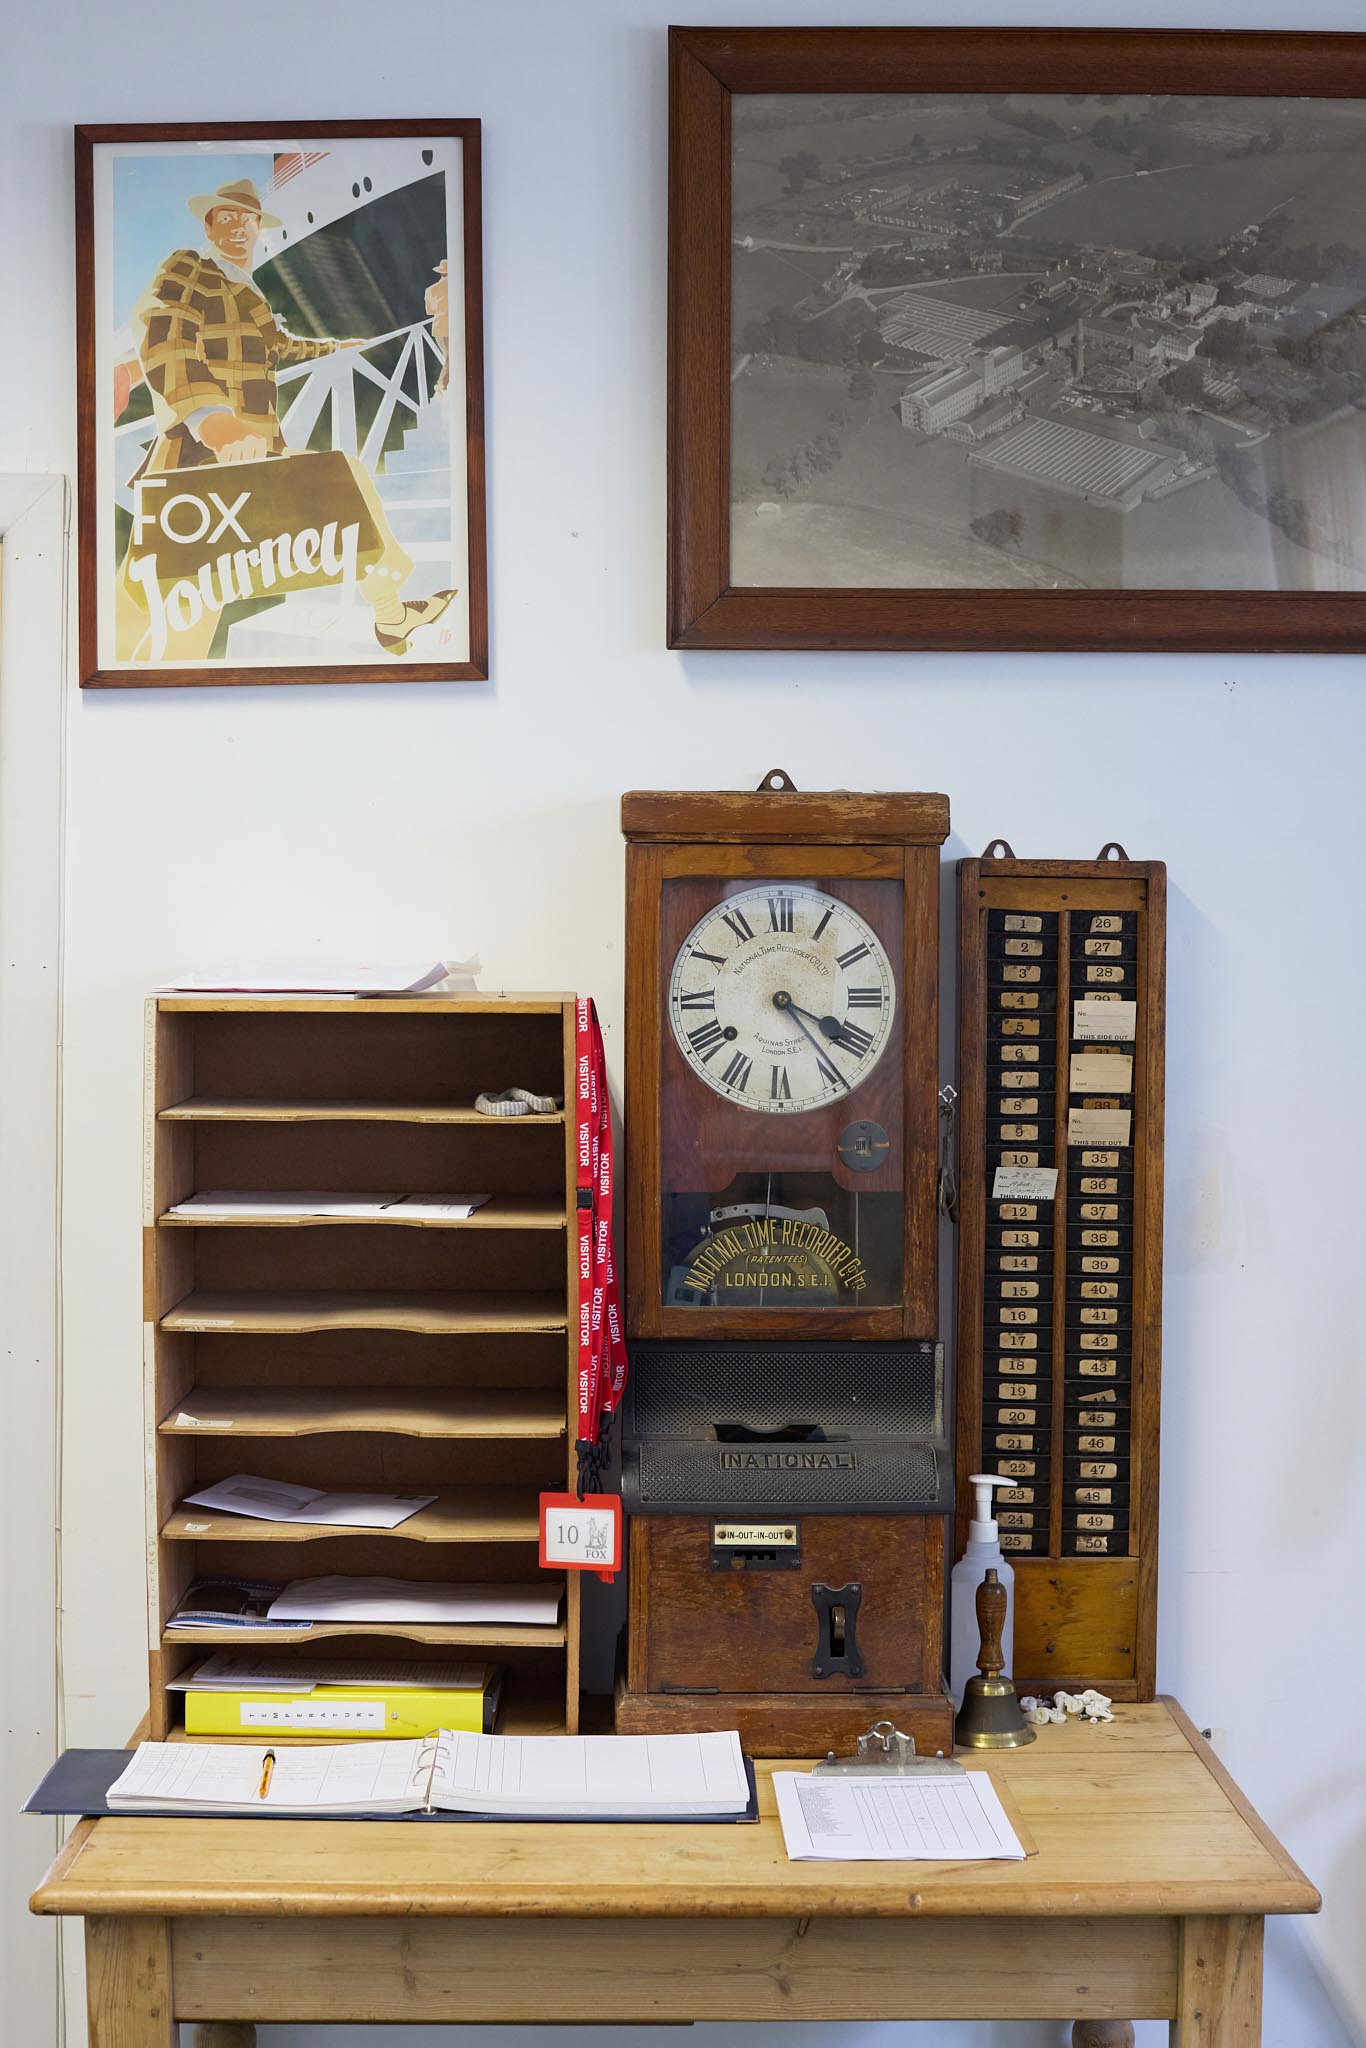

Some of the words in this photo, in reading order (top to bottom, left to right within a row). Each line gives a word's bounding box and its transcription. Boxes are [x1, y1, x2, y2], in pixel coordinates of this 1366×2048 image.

[766, 898, 795, 933] XII
[1020, 920, 1027, 929] 1
[1095, 919, 1112, 928] 26
[1021, 943, 1028, 952] 2
[1094, 943, 1111, 952] 27
[1019, 969, 1027, 978] 3
[1096, 968, 1113, 977] 28
[1016, 996, 1025, 1005] 4
[1016, 1022, 1024, 1031] 5
[762, 1046, 786, 1056] LONDON
[1015, 1049, 1024, 1058] 6
[579, 1055, 589, 1100] VISITOR
[1016, 1075, 1024, 1085] 7
[1014, 1101, 1022, 1110] 8
[1015, 1128, 1024, 1137] 9
[579, 1122, 590, 1167] VISITOR
[1012, 1155, 1028, 1165] 10
[1091, 1154, 1108, 1163] 35
[600, 1153, 610, 1196] VISITOR
[1090, 1180, 1107, 1190] 36
[1012, 1208, 1028, 1217] 12
[1091, 1207, 1107, 1216] 37
[596, 1220, 609, 1264] VISITOR
[1014, 1234, 1029, 1243] 13
[1091, 1233, 1107, 1243] 38
[580, 1235, 590, 1279] VISITOR
[683, 1230, 747, 1292] NATIONAL
[741, 1219, 778, 1249] TIME
[782, 1219, 852, 1269] RECORDER
[1012, 1259, 1028, 1268] 14
[1091, 1261, 1108, 1270] 39
[1012, 1287, 1028, 1296] 15
[1090, 1285, 1107, 1295] 40
[591, 1287, 604, 1331] VISITOR
[1010, 1311, 1026, 1321] 16
[1092, 1311, 1108, 1321] 41
[581, 1302, 590, 1346] VISITOR
[608, 1304, 617, 1344] VISITOR
[1010, 1336, 1026, 1346] 17
[1092, 1337, 1109, 1347] 42
[1008, 1360, 1025, 1370] 18
[1090, 1363, 1107, 1373] 43
[579, 1369, 589, 1414] VISITOR
[1010, 1387, 1026, 1396] 19
[1009, 1412, 1026, 1421] 20
[1088, 1414, 1105, 1423] 45
[1007, 1439, 1023, 1449] 21
[1088, 1439, 1105, 1448] 46
[726, 1453, 850, 1469] NATIONAL
[1009, 1464, 1026, 1473] 22
[1090, 1465, 1106, 1475] 47
[1008, 1490, 1025, 1499] 23
[1084, 1492, 1100, 1501] 48
[1008, 1515, 1025, 1525] 24
[1087, 1517, 1103, 1526] 49
[557, 1525, 579, 1545] 10
[1005, 1536, 1021, 1545] 25
[1085, 1539, 1102, 1548] 50
[585, 1550, 607, 1560] FOX
